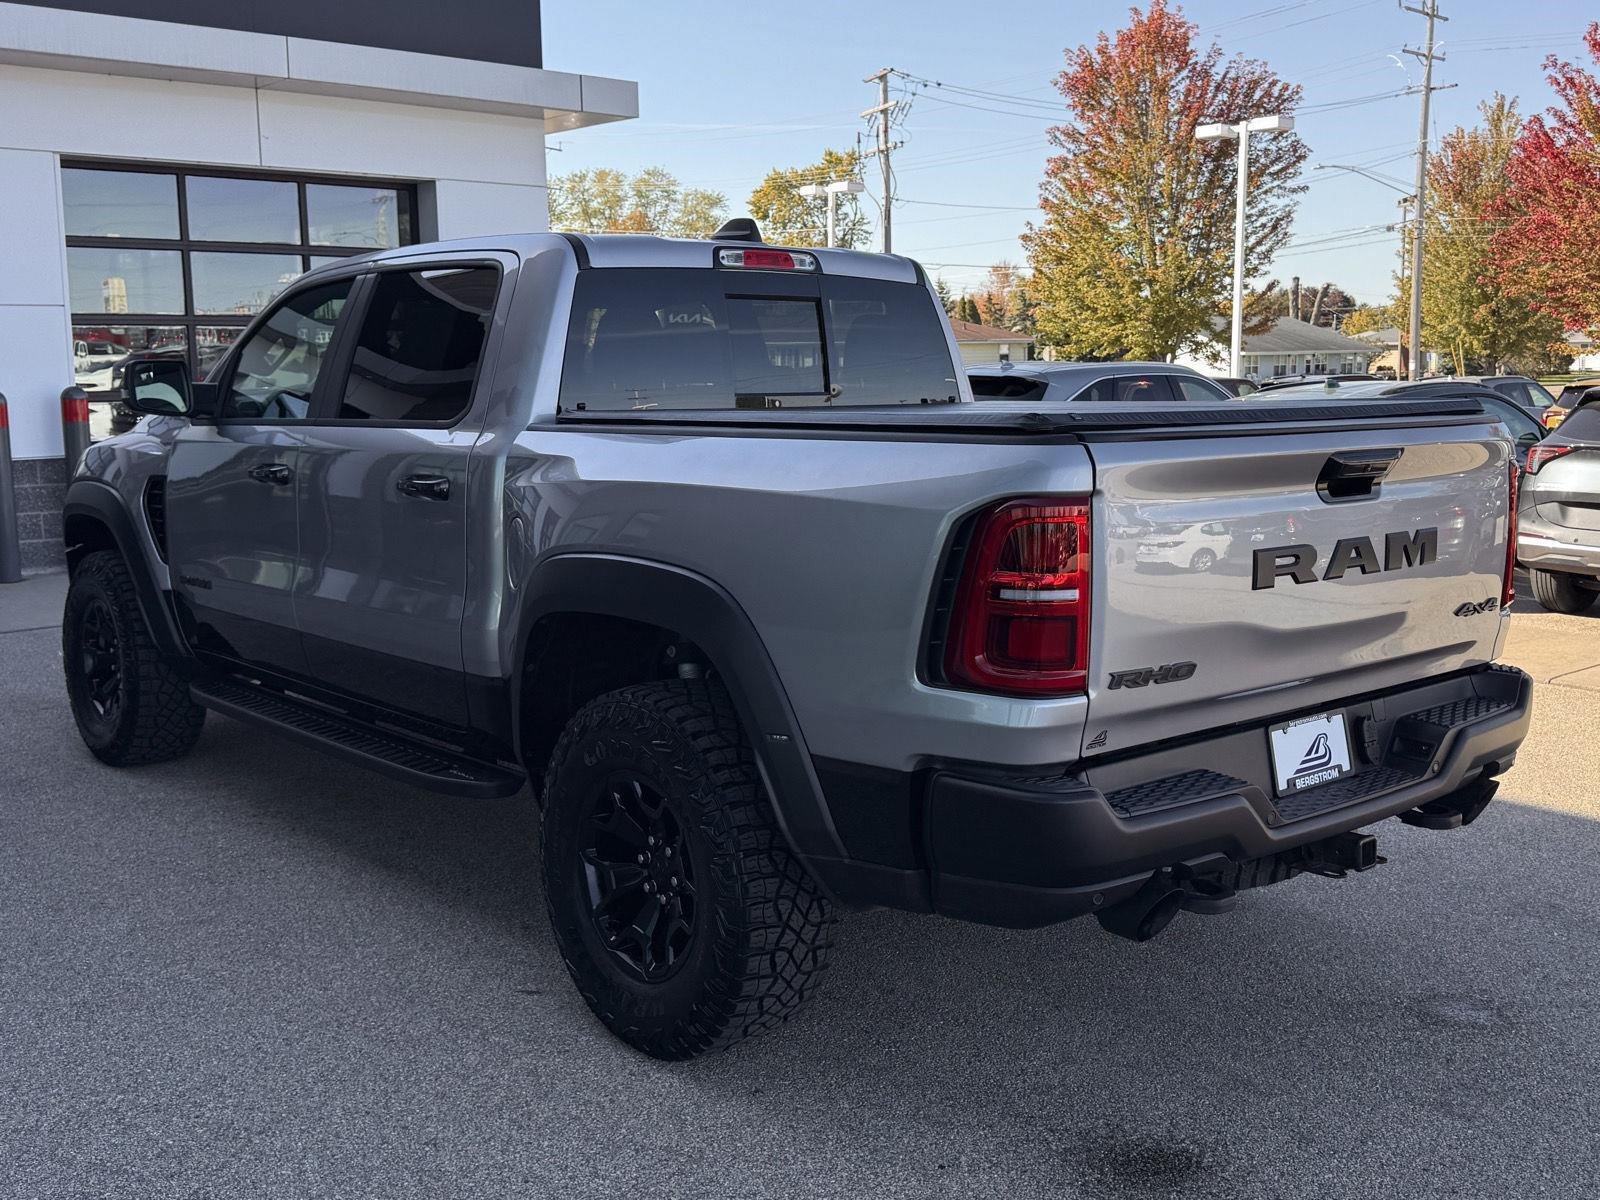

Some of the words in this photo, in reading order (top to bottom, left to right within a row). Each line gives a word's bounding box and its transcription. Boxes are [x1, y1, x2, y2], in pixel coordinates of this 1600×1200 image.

[1252, 527, 1438, 591] RAM
[1108, 661, 1197, 690] RHO
[1295, 767, 1339, 789] BERGSTROM
